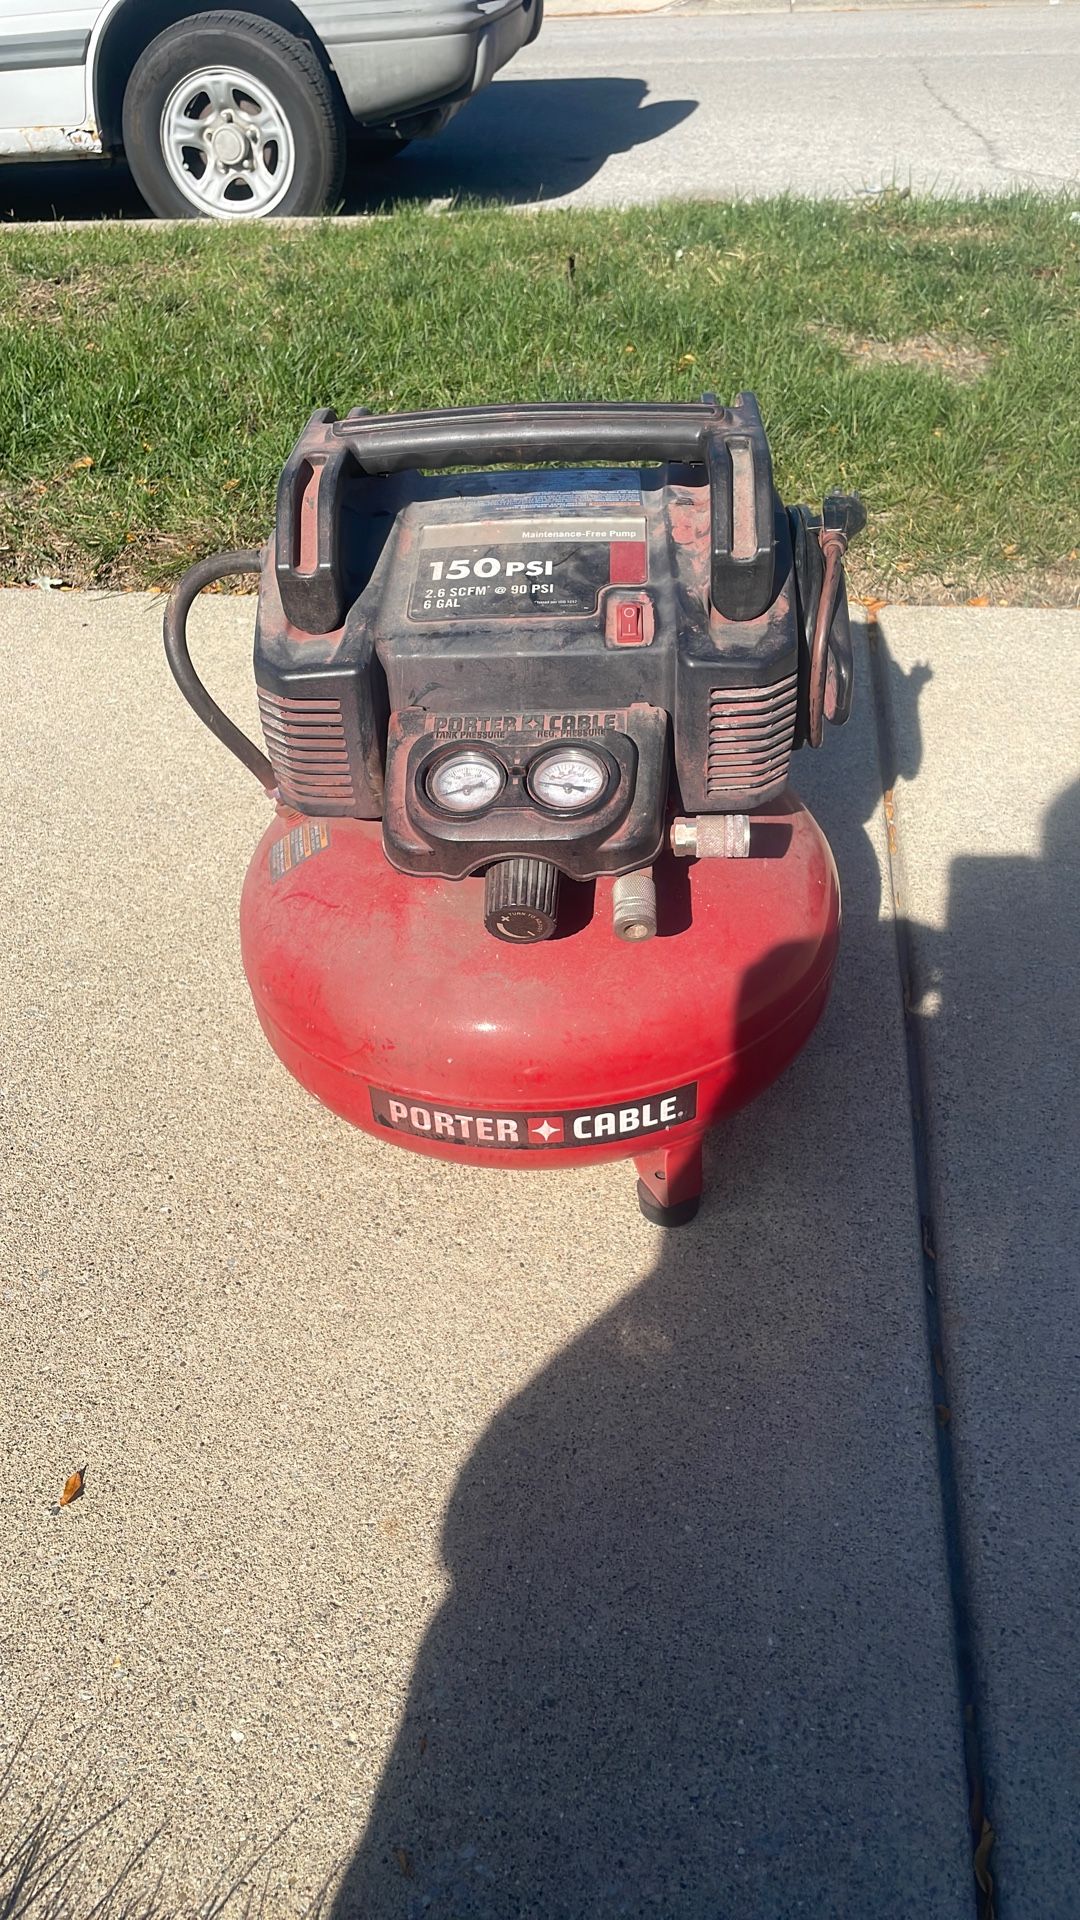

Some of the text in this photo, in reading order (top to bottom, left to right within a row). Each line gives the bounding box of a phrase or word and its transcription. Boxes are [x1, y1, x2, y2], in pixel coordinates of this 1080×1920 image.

[522, 529, 636, 538] Maintenance-Free Pump
[429, 557, 553, 581] 150 PSI
[425, 588, 445, 598] 2.6
[494, 586, 507, 595] @
[510, 584, 527, 595] 90
[531, 584, 554, 594] PSI
[423, 599, 461, 609] 6 GAL
[435, 714, 616, 732] PORTER CABLE
[436, 731, 505, 739] TANK PRESSURE
[560, 729, 606, 738] PRESSURE
[388, 1096, 678, 1142] PORTER CABLE
